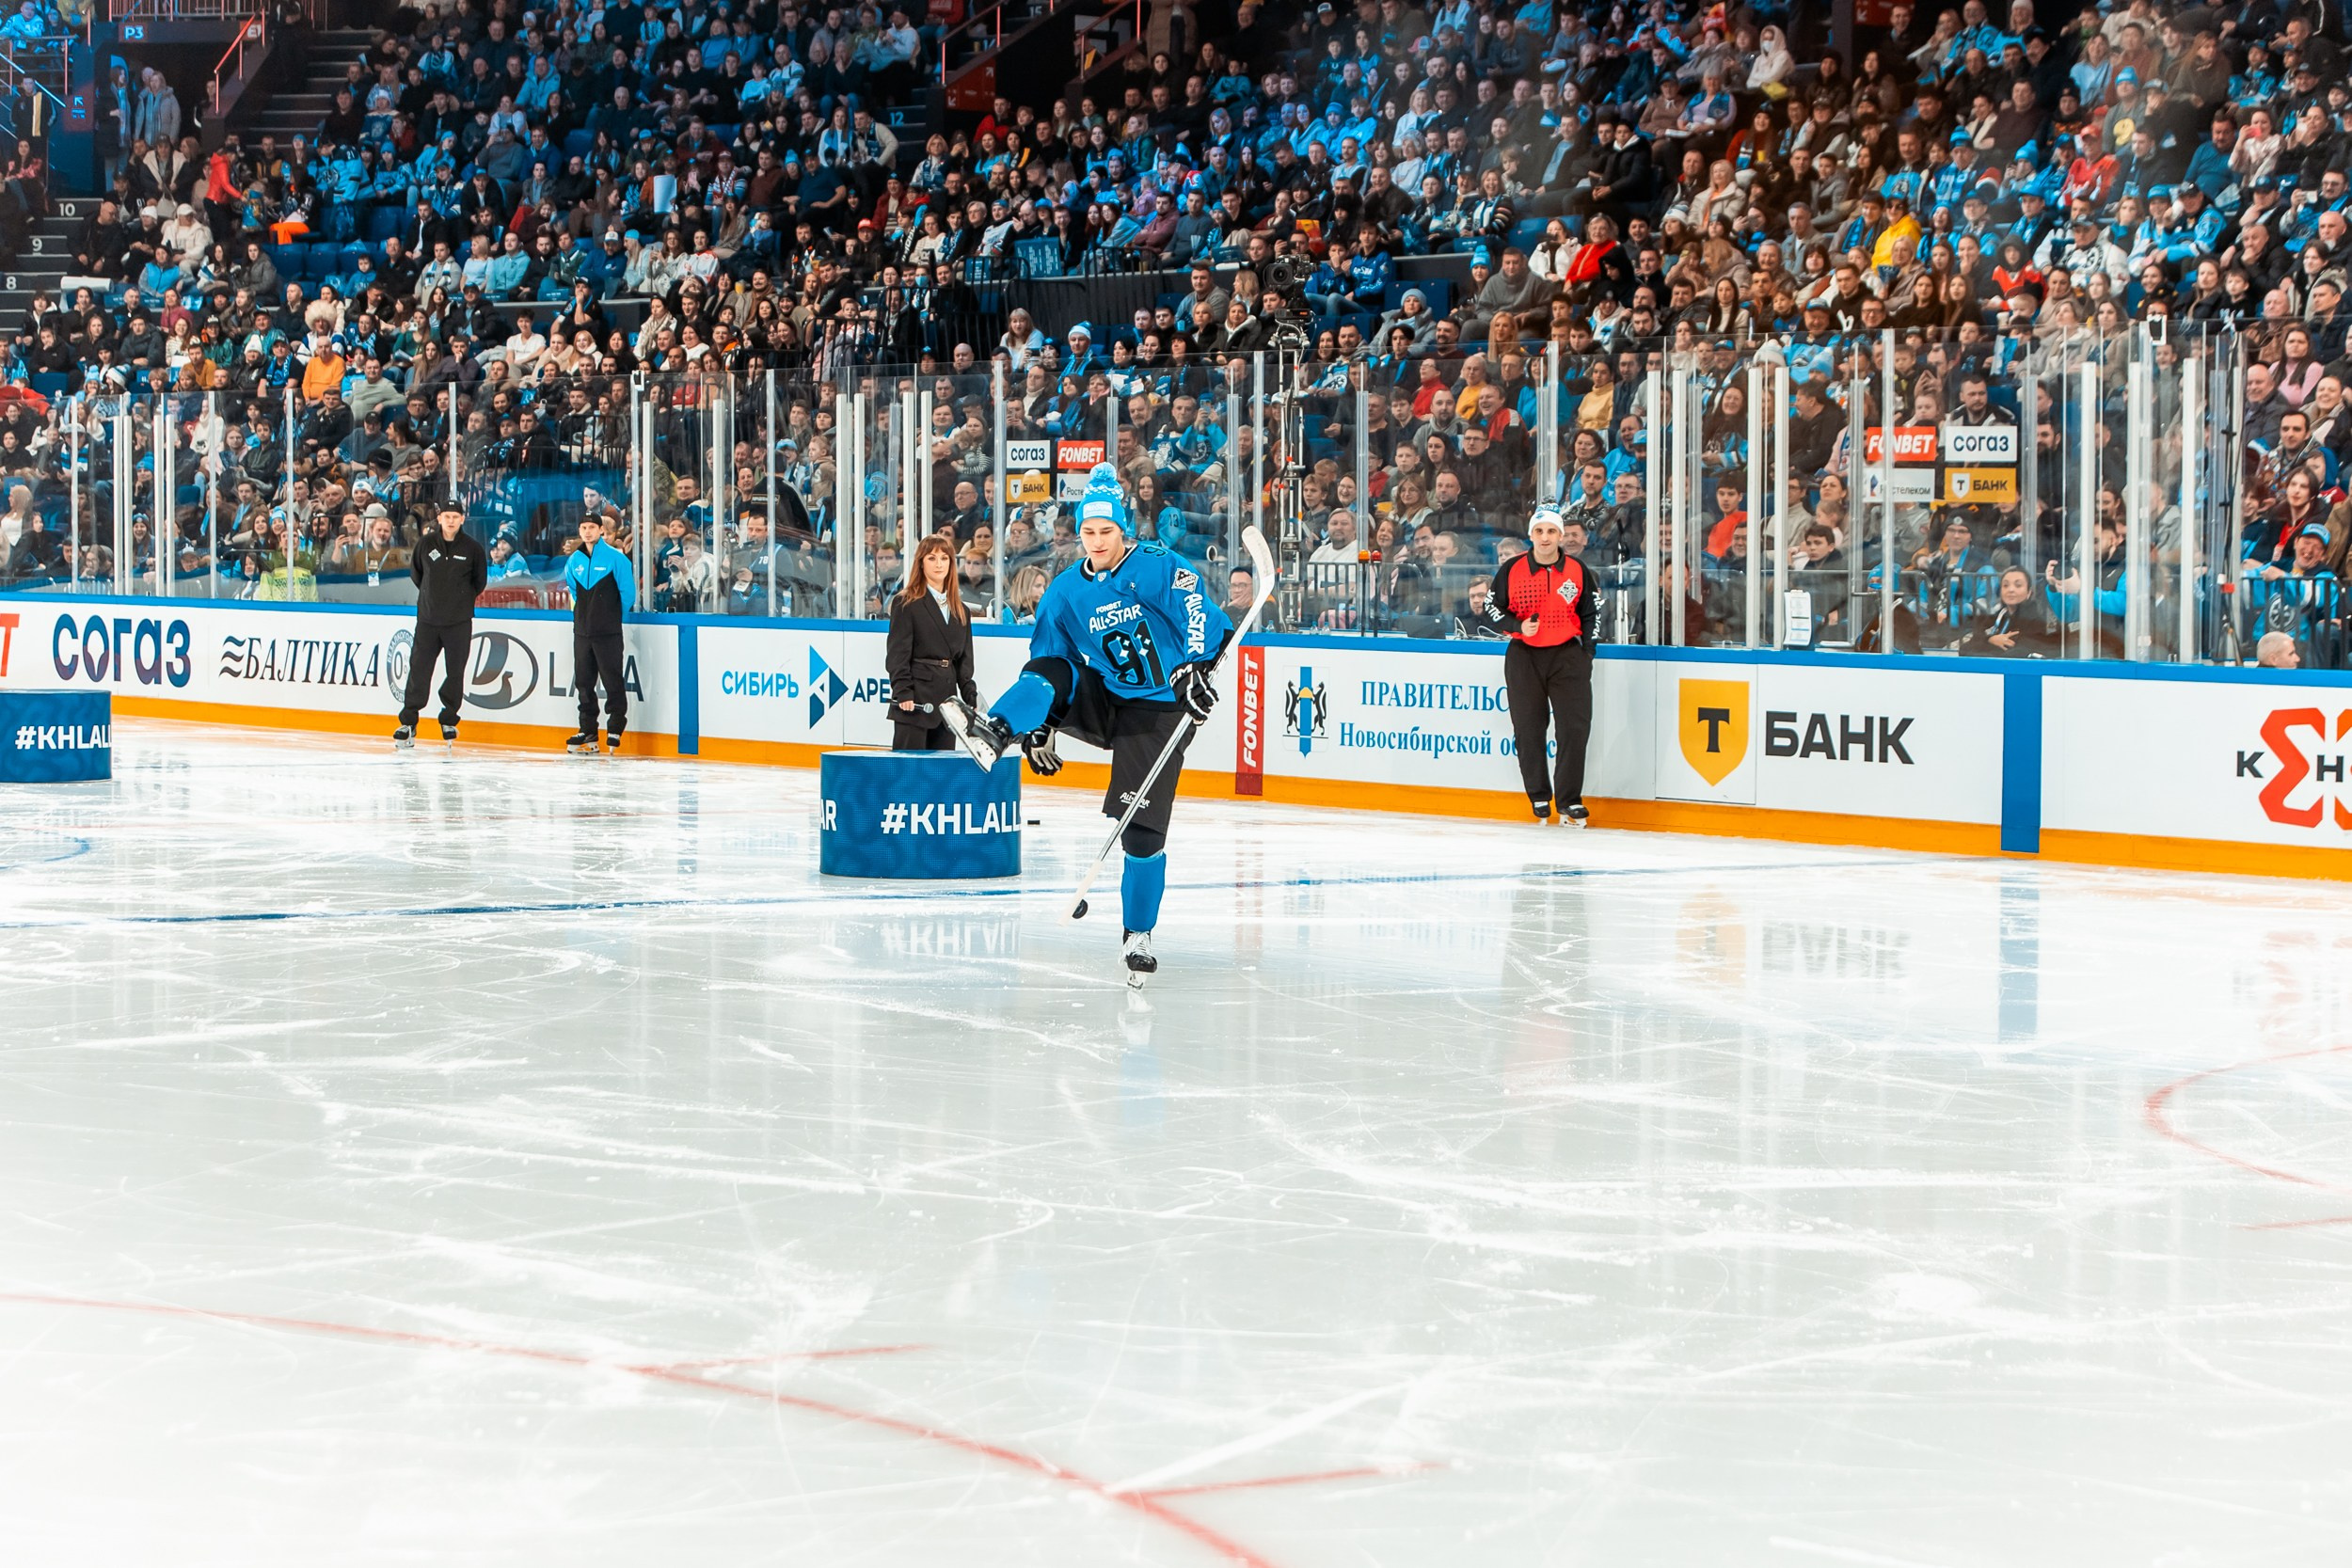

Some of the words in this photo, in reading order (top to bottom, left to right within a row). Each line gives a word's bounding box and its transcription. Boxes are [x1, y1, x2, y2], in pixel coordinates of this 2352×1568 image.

[124, 25, 144, 40] P3
[889, 111, 904, 126] 12
[59, 202, 75, 217] 10
[32, 237, 42, 252] 9
[6, 276, 17, 290] 8
[1057, 447, 1104, 463] FONBET
[1023, 483, 1045, 493] БАНК
[1066, 486, 1084, 496] Росте
[1972, 480, 2009, 492] БАНК
[1095, 600, 1122, 614] FONBET
[1101, 618, 1168, 689] 91
[243, 637, 380, 688] БАЛТИКА
[548, 651, 644, 702] LA
[722, 670, 799, 699] СИБИРЬ
[851, 677, 892, 704] АРЕ
[1361, 680, 1510, 713] ПРАВИТЕЛЬС
[1243, 654, 1259, 768] FONBET
[1340, 722, 1492, 759] Новосибирской
[1765, 710, 1915, 765] БАНК
